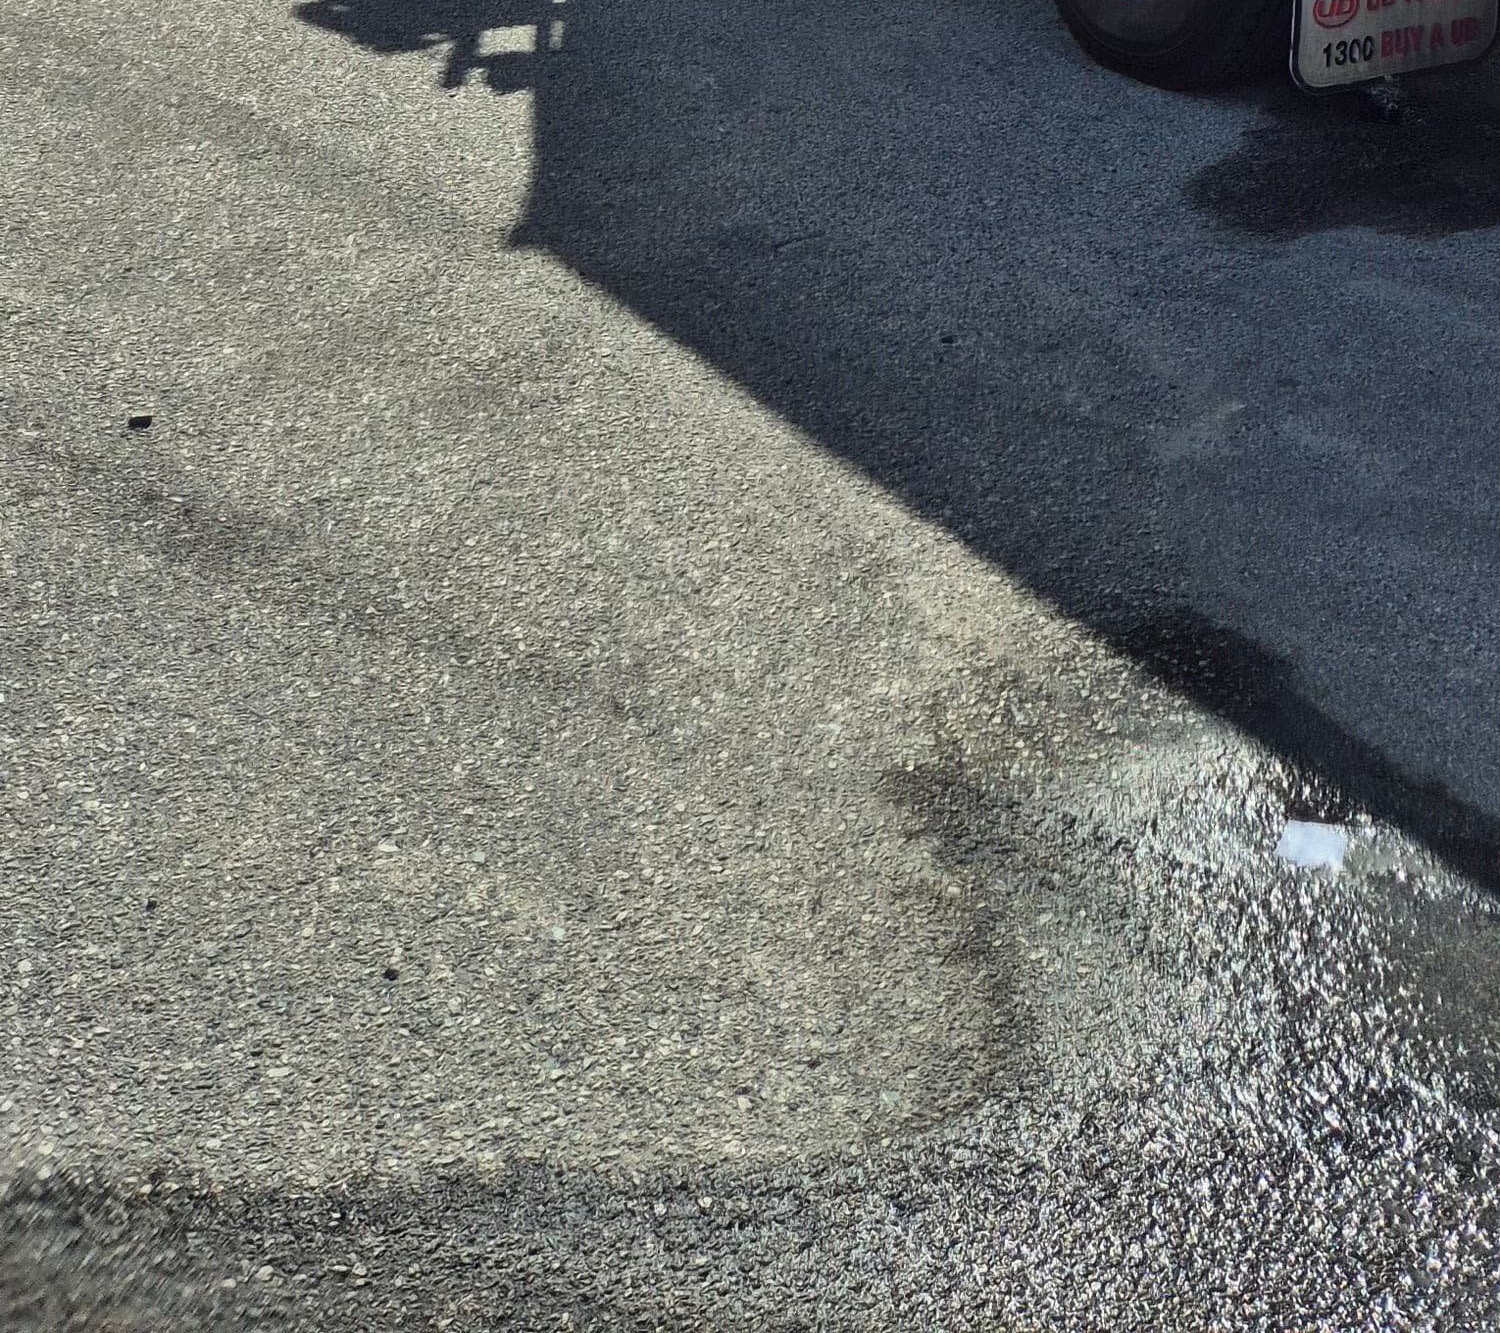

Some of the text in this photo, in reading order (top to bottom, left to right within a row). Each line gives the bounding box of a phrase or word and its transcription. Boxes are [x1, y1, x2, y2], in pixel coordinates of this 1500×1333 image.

[1323, 36, 1375, 68] 1300
[1380, 26, 1423, 58] BUY
[1430, 23, 1444, 51] A
